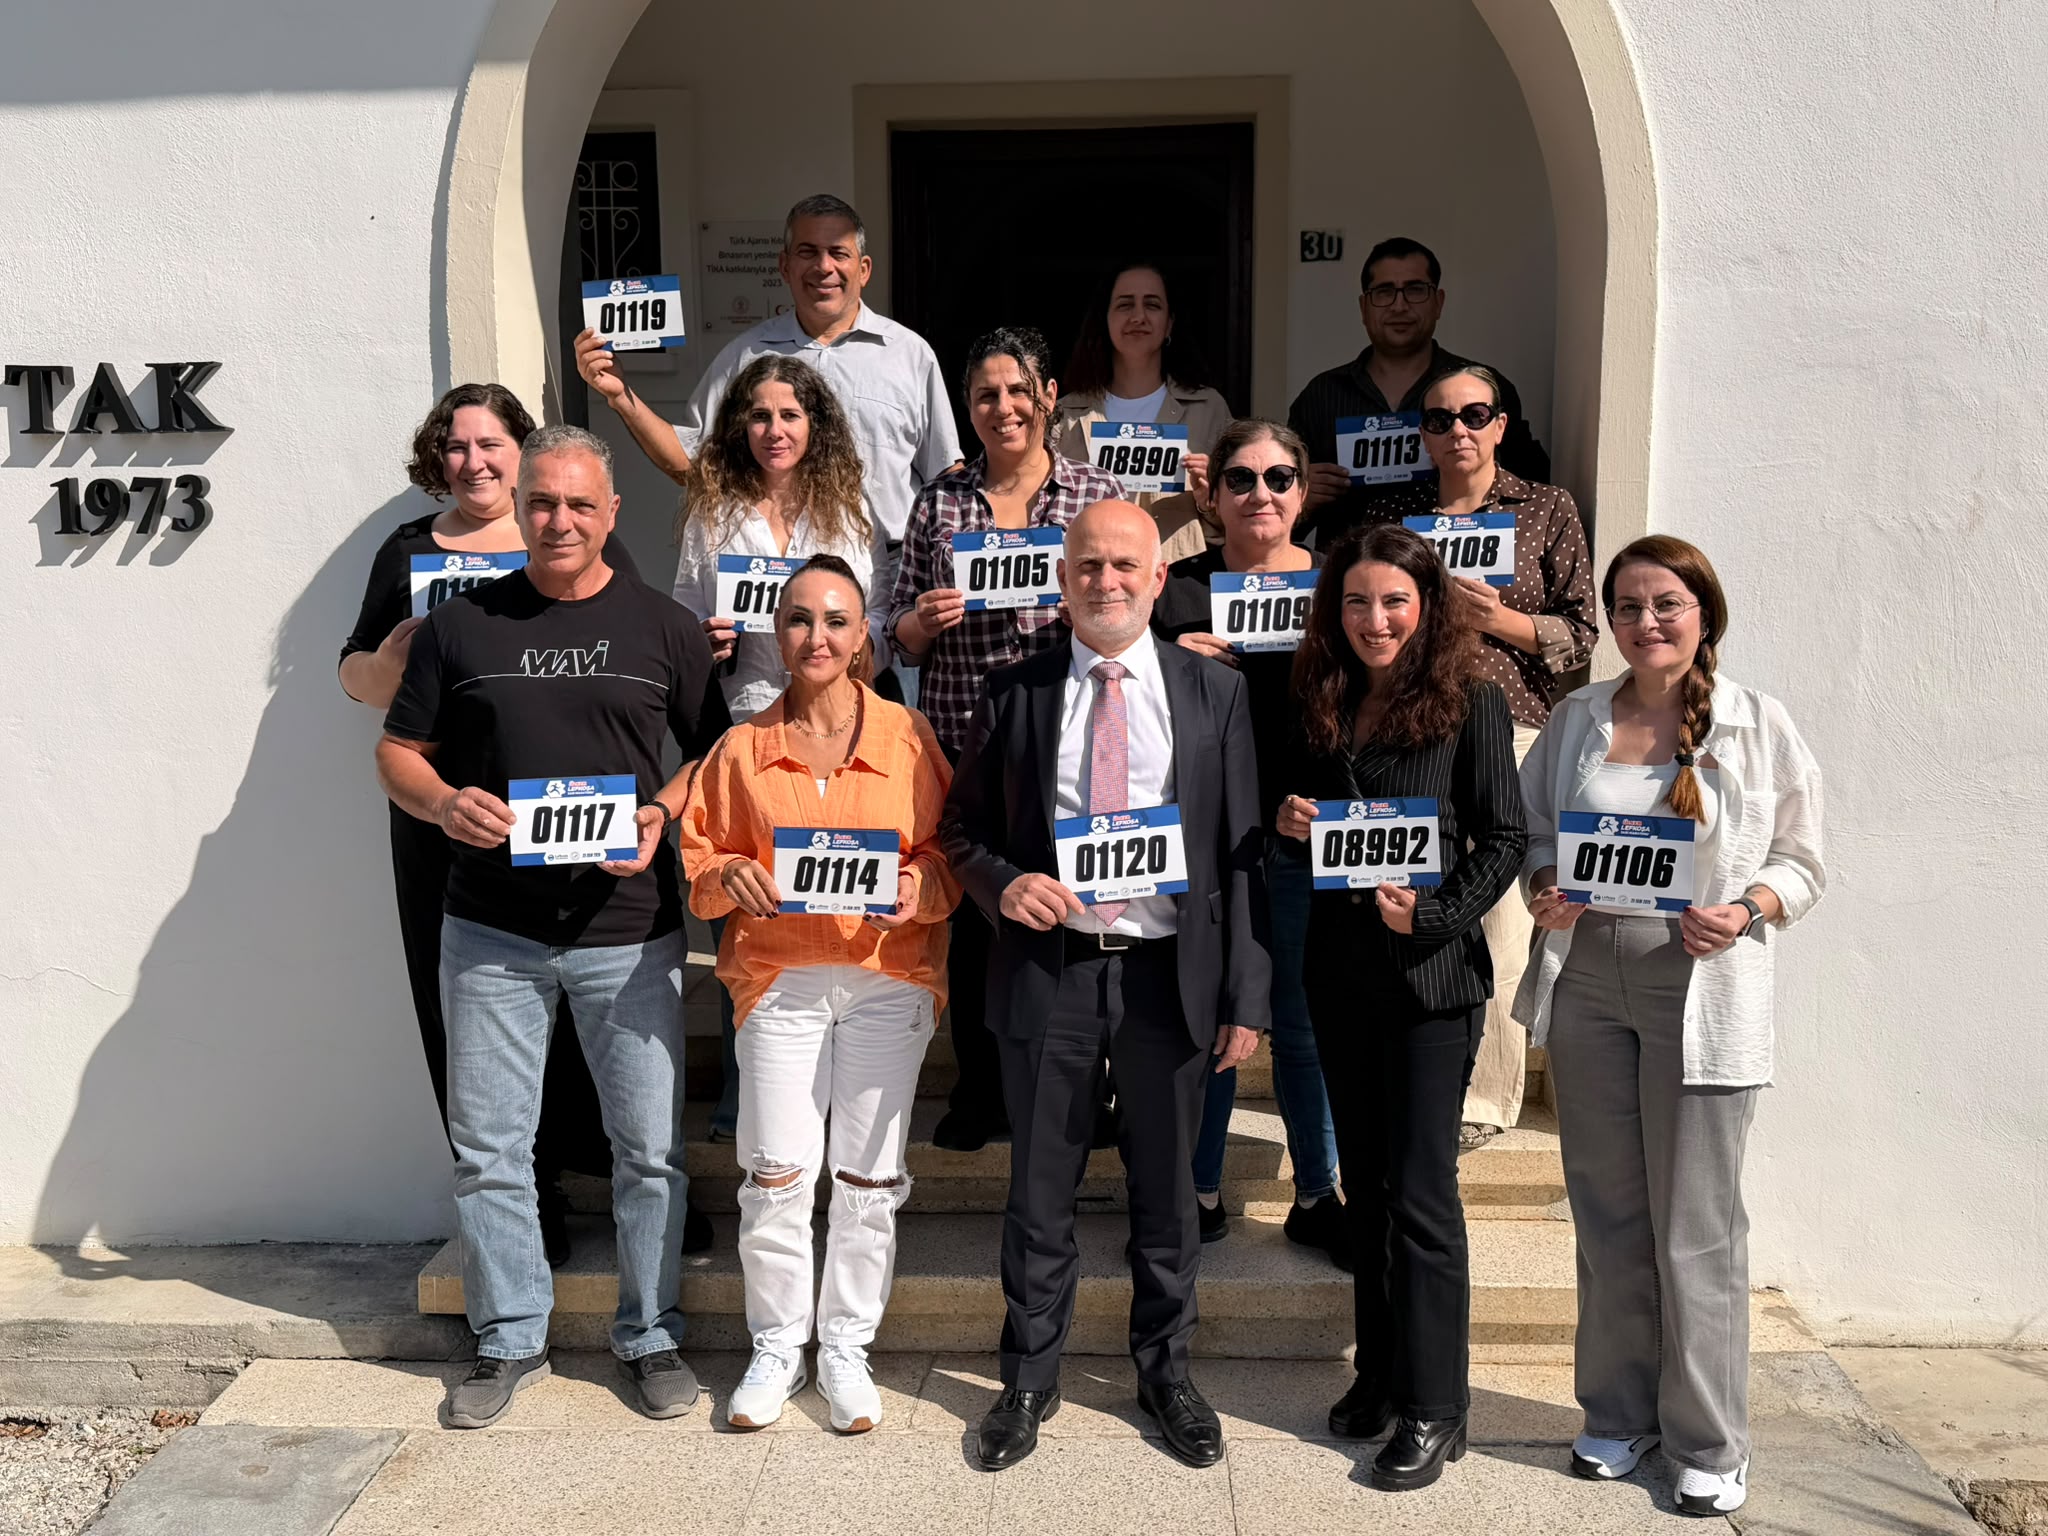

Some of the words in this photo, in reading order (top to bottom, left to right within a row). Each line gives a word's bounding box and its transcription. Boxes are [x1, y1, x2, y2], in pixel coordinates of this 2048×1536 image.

[1303, 231, 1338, 260] 30
[600, 299, 666, 334] 01119
[5, 361, 235, 434] TAK
[1098, 445, 1180, 476] 08990
[1352, 433, 1421, 469] 01113
[50, 474, 213, 536] 1973
[1425, 535, 1500, 568] 1108
[969, 553, 1049, 591] 01105
[1227, 596, 1312, 633] 01109
[531, 803, 616, 844] 01117
[1076, 835, 1167, 882] 01120
[1322, 826, 1430, 868] 08992
[1573, 842, 1677, 888] 01106
[793, 856, 880, 895] 01114
